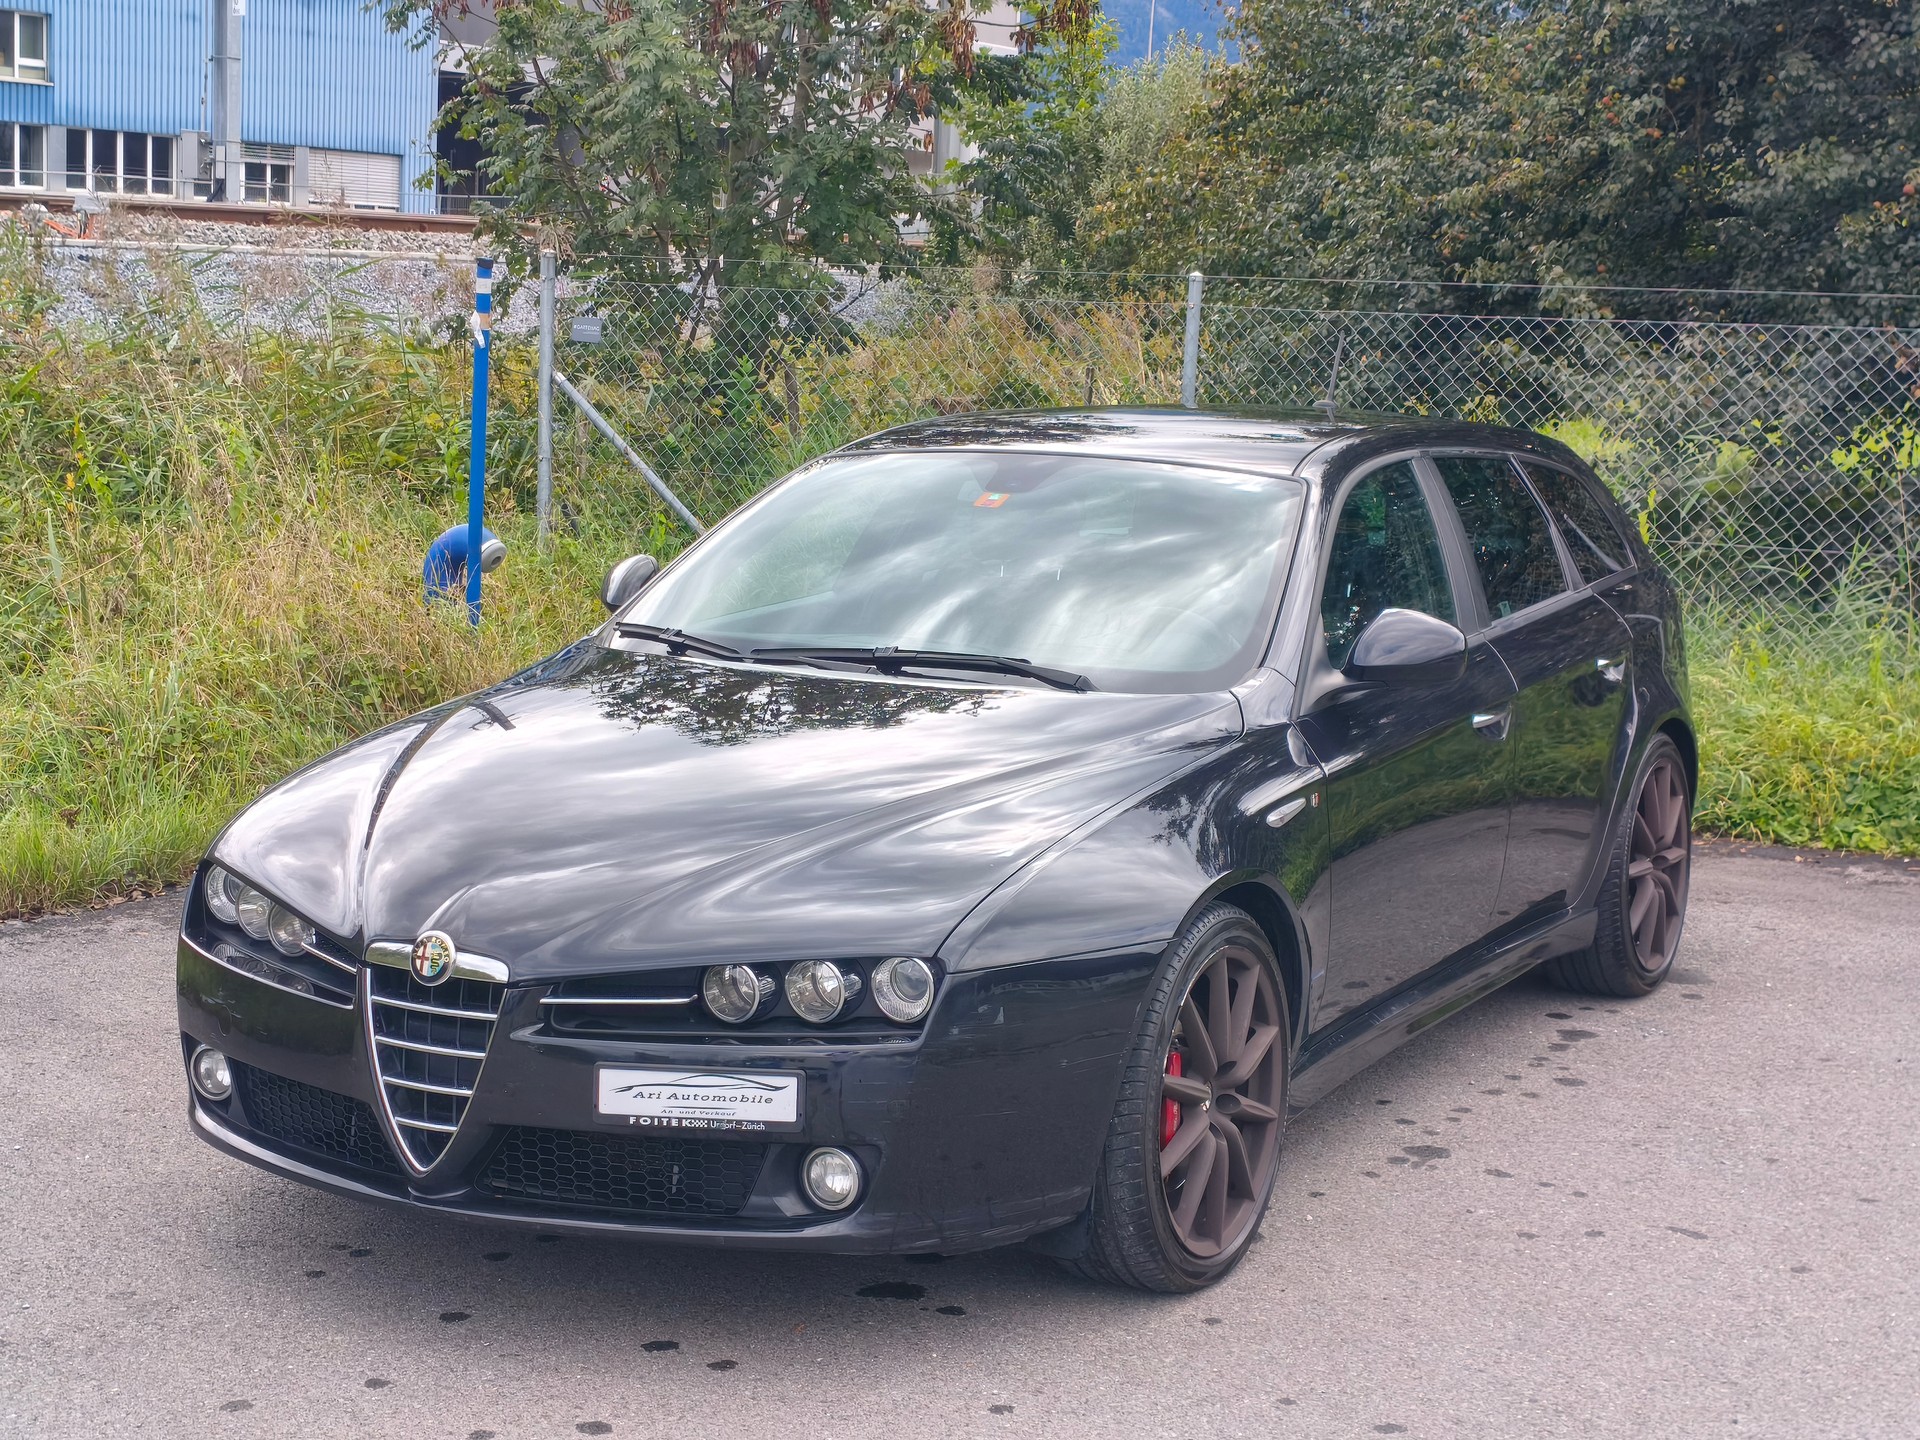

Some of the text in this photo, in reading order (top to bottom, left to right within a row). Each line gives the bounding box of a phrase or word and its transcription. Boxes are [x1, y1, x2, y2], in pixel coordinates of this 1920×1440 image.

[632, 1091, 774, 1104] Ari Automobile
[629, 1116, 692, 1127] FOITEK
